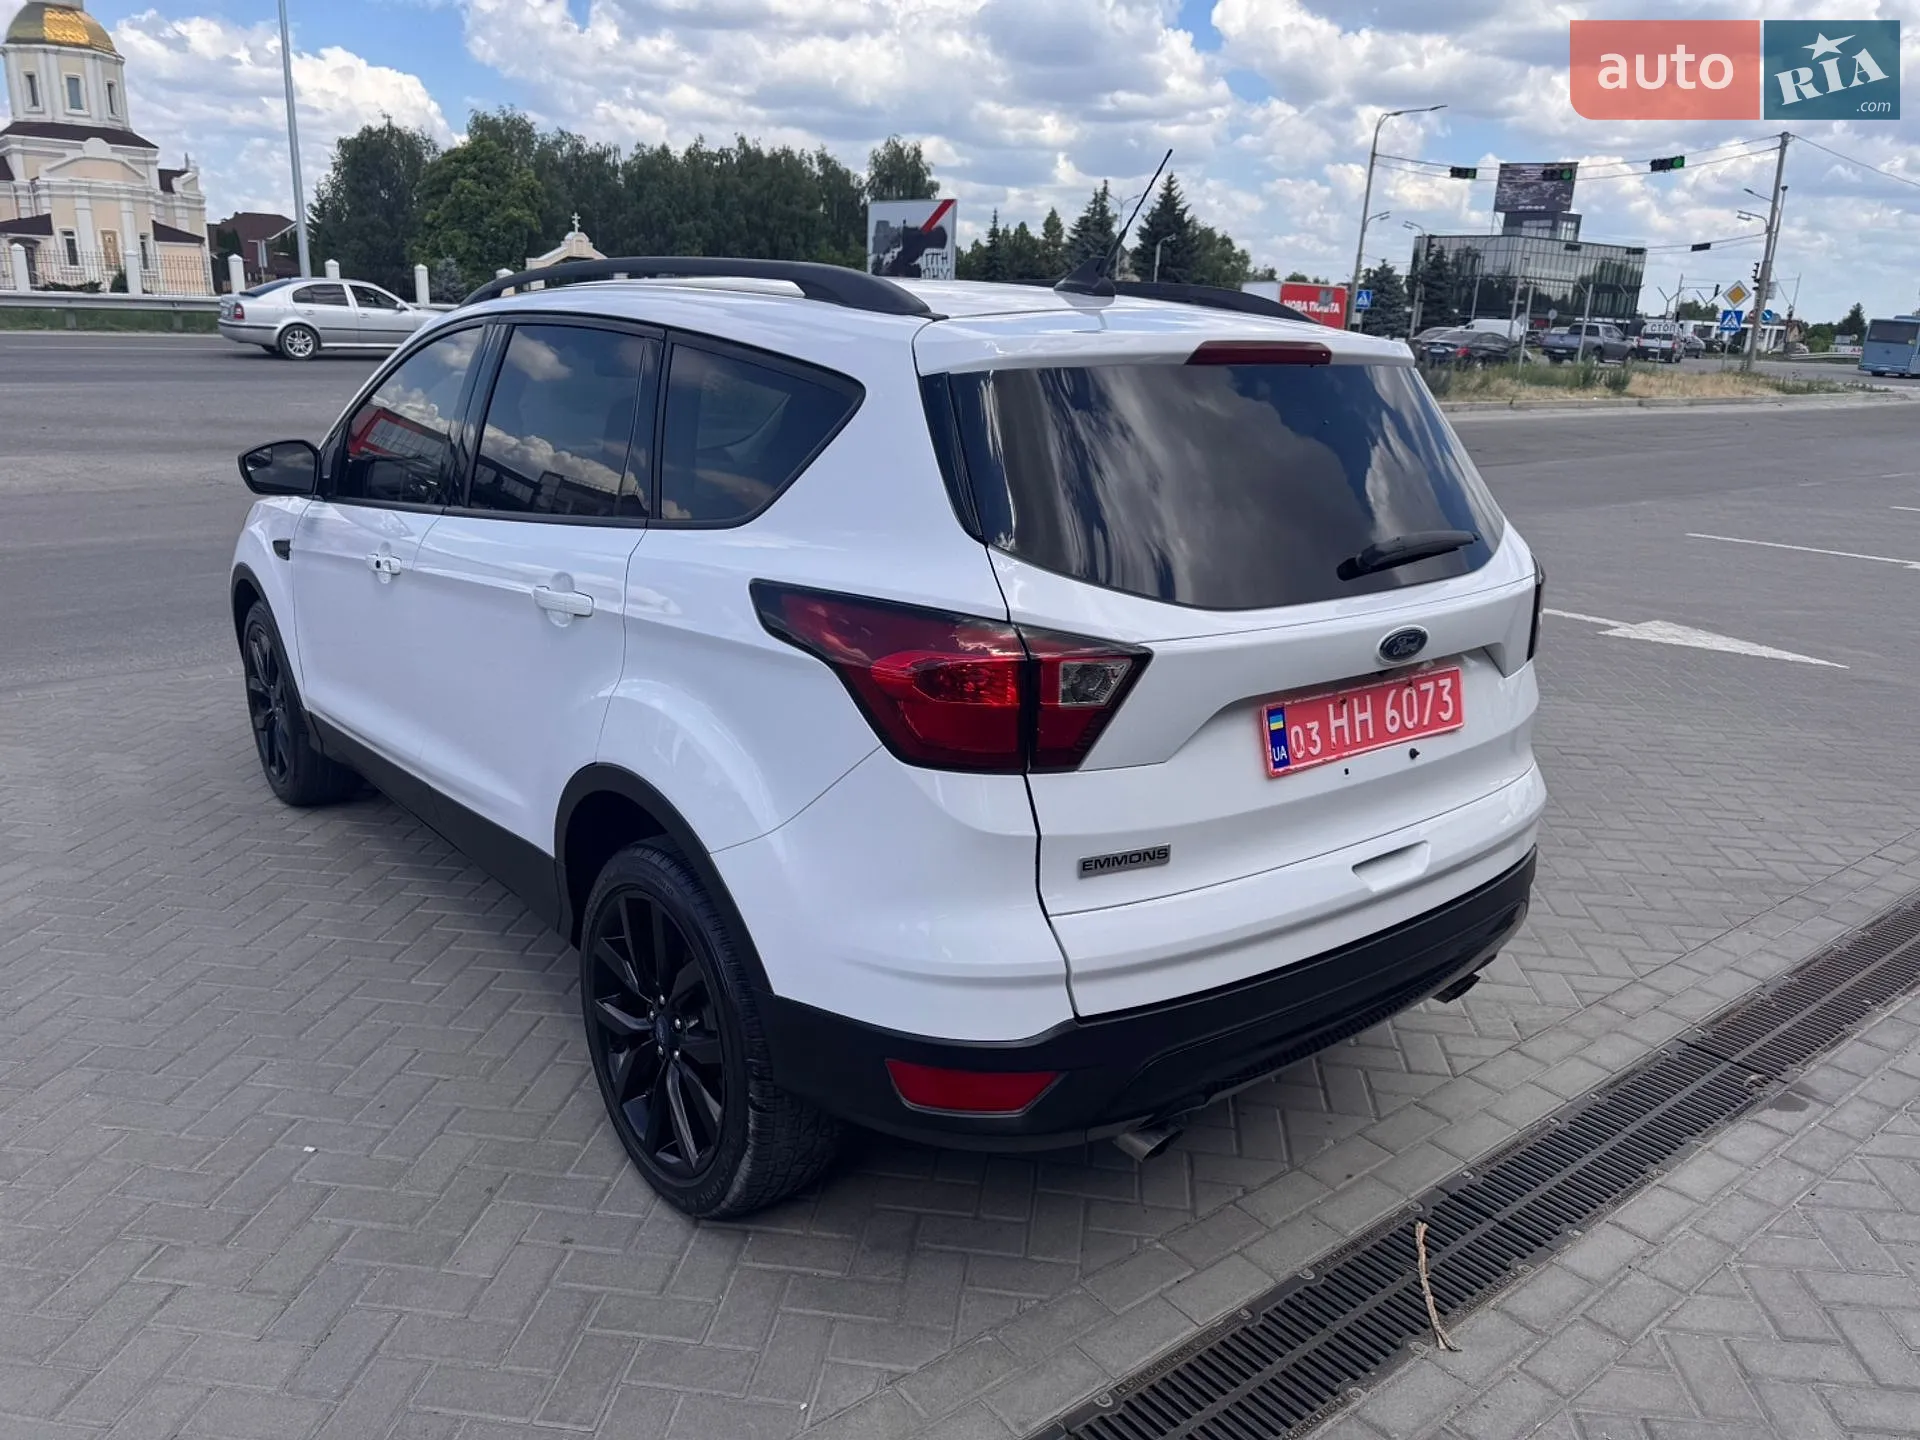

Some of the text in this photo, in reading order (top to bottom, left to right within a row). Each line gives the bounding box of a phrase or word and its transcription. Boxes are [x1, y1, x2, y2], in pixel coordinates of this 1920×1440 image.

[1290, 720, 1322, 759] 03
[1385, 677, 1454, 734] 6073
[1272, 744, 1288, 763] UA
[1082, 847, 1169, 872] EMMONS
